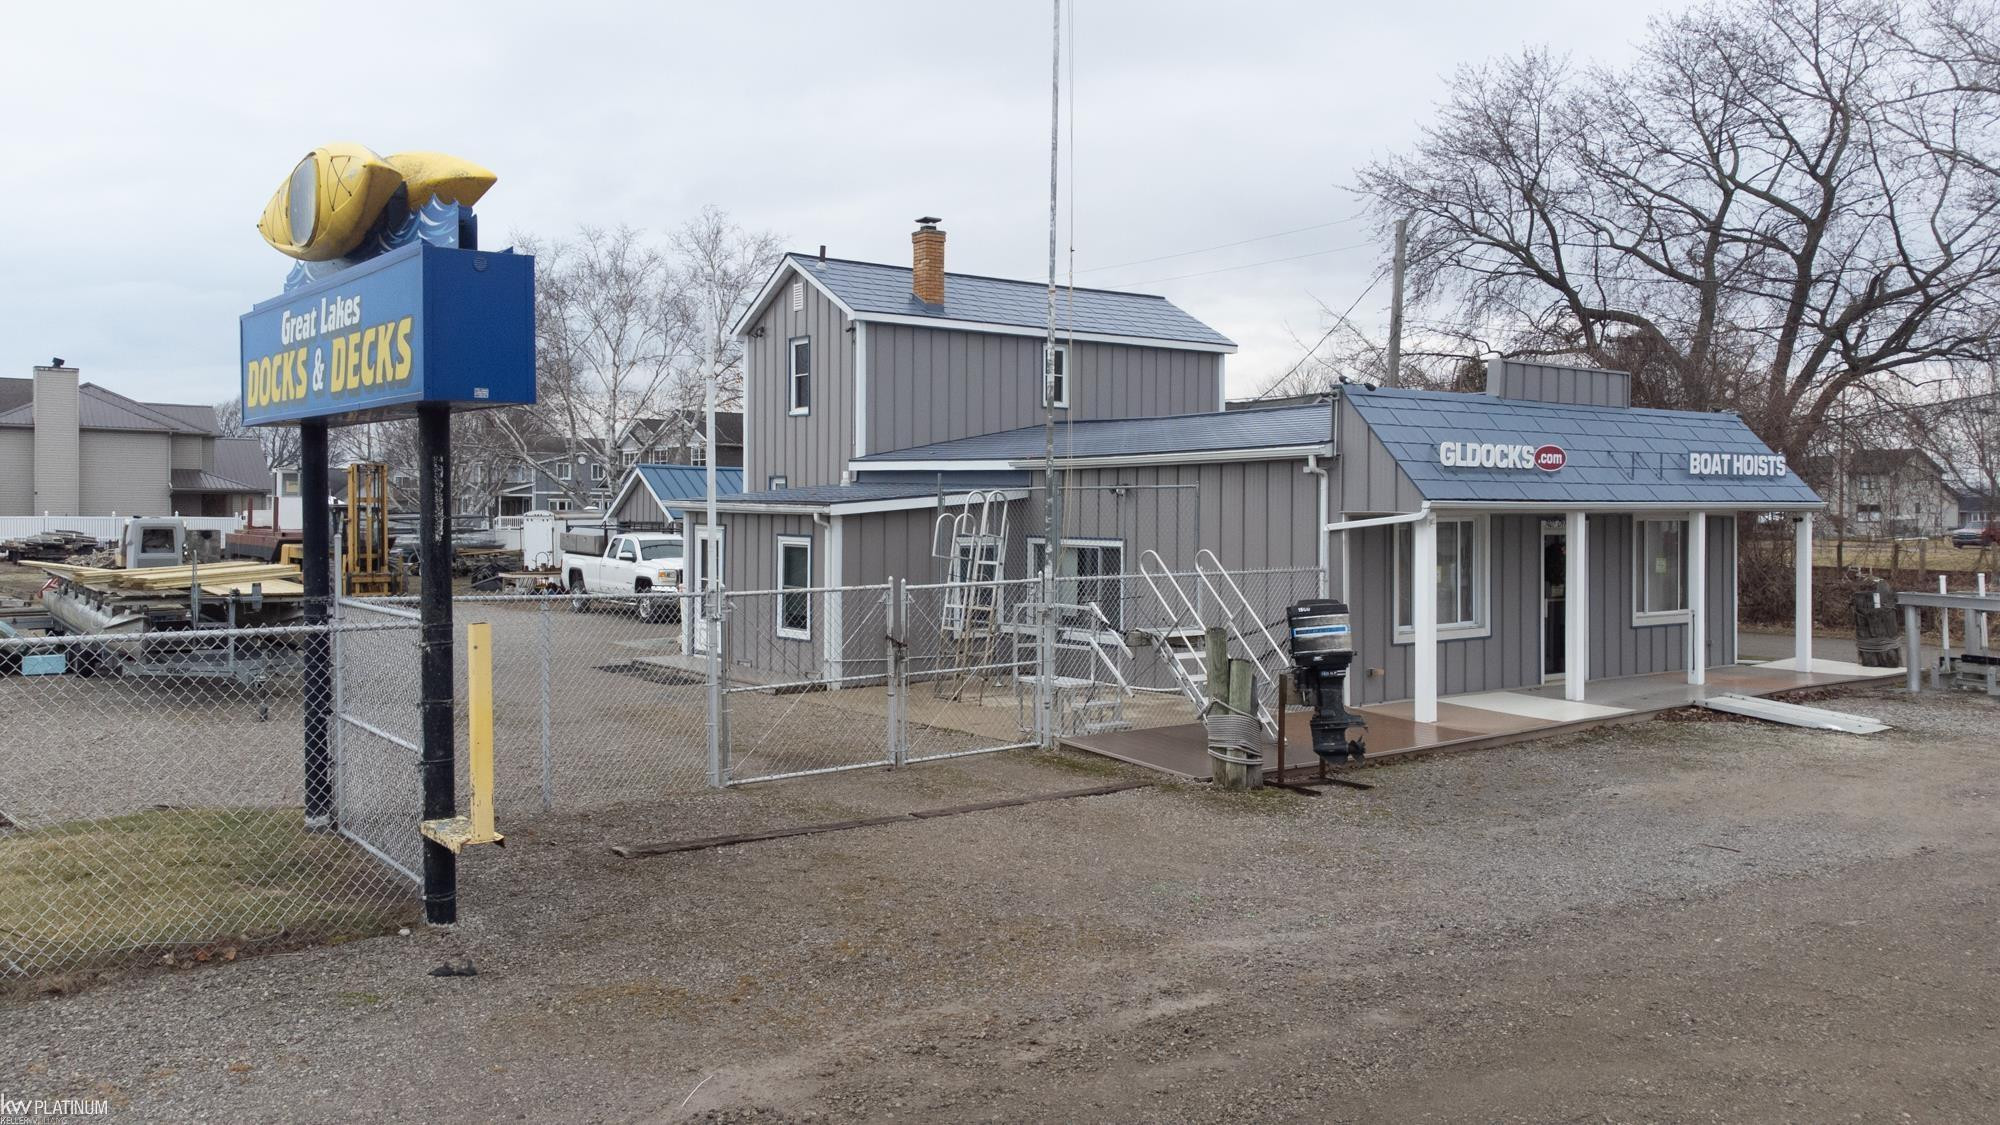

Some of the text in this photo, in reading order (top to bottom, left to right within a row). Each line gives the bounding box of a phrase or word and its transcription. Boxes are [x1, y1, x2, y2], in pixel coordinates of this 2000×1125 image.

[281, 295, 361, 345] Great Lakes
[247, 317, 412, 408] DOCKS & DECKS
[1689, 452, 1786, 477] BOAT HOISTS
